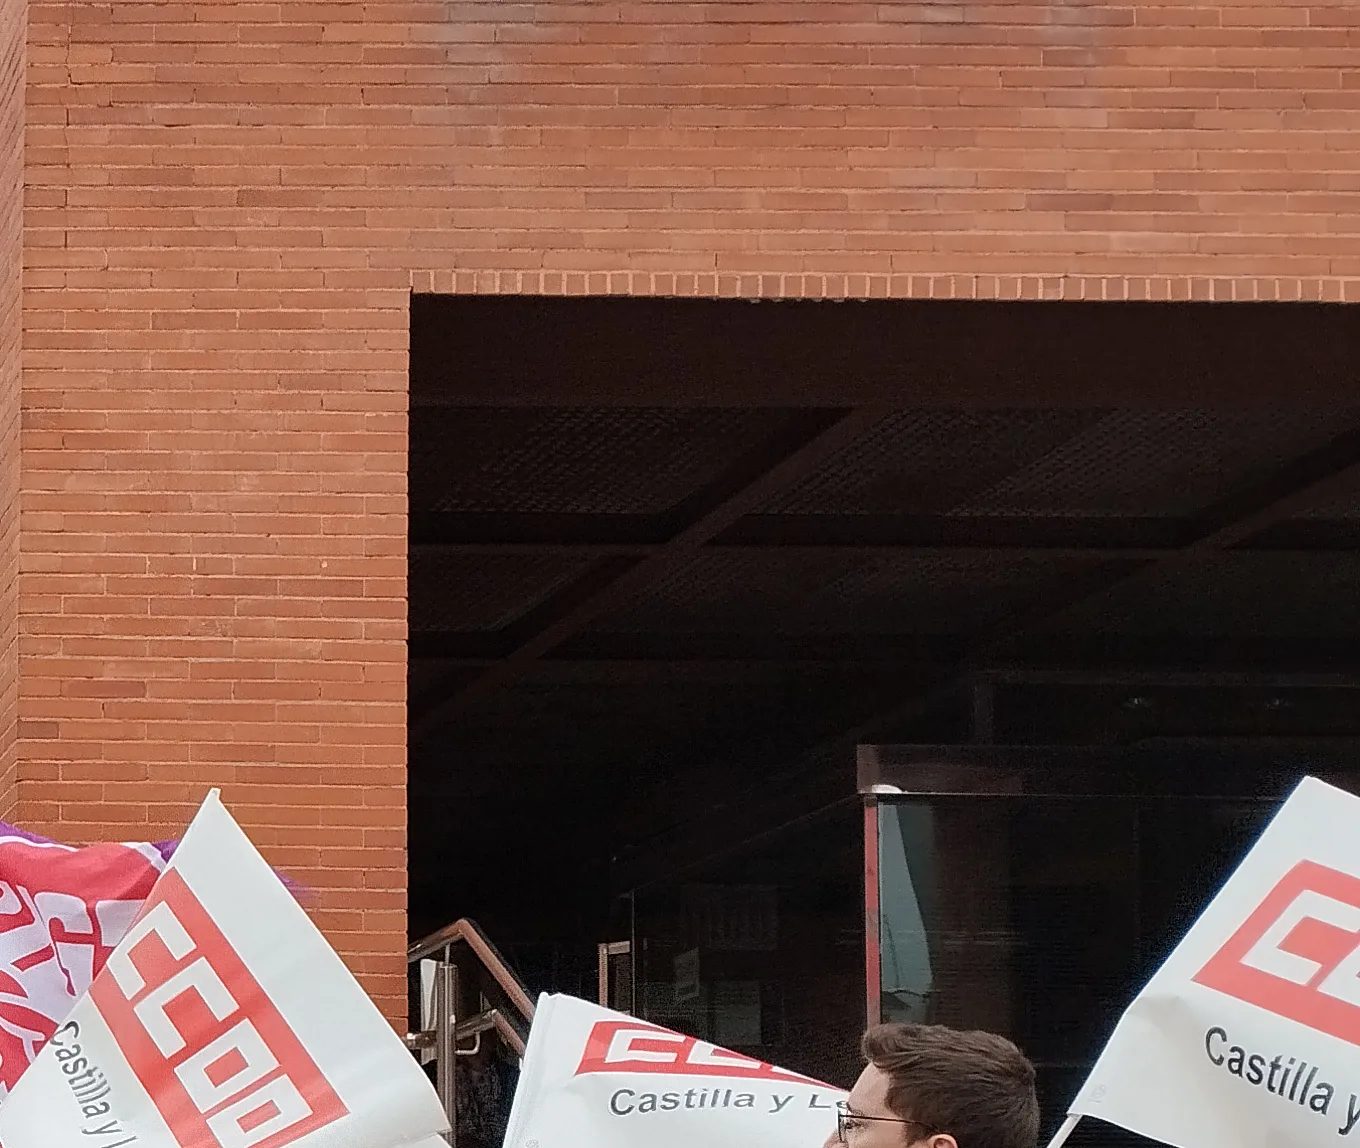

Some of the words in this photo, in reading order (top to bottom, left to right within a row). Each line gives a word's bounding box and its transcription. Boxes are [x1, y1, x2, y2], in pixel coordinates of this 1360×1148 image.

[49, 1020, 112, 1119] Castilla
[81, 1119, 123, 1138] y
[610, 1088, 754, 1116] Castilla
[768, 1094, 795, 1114] y
[1204, 1026, 1335, 1116] Castilla
